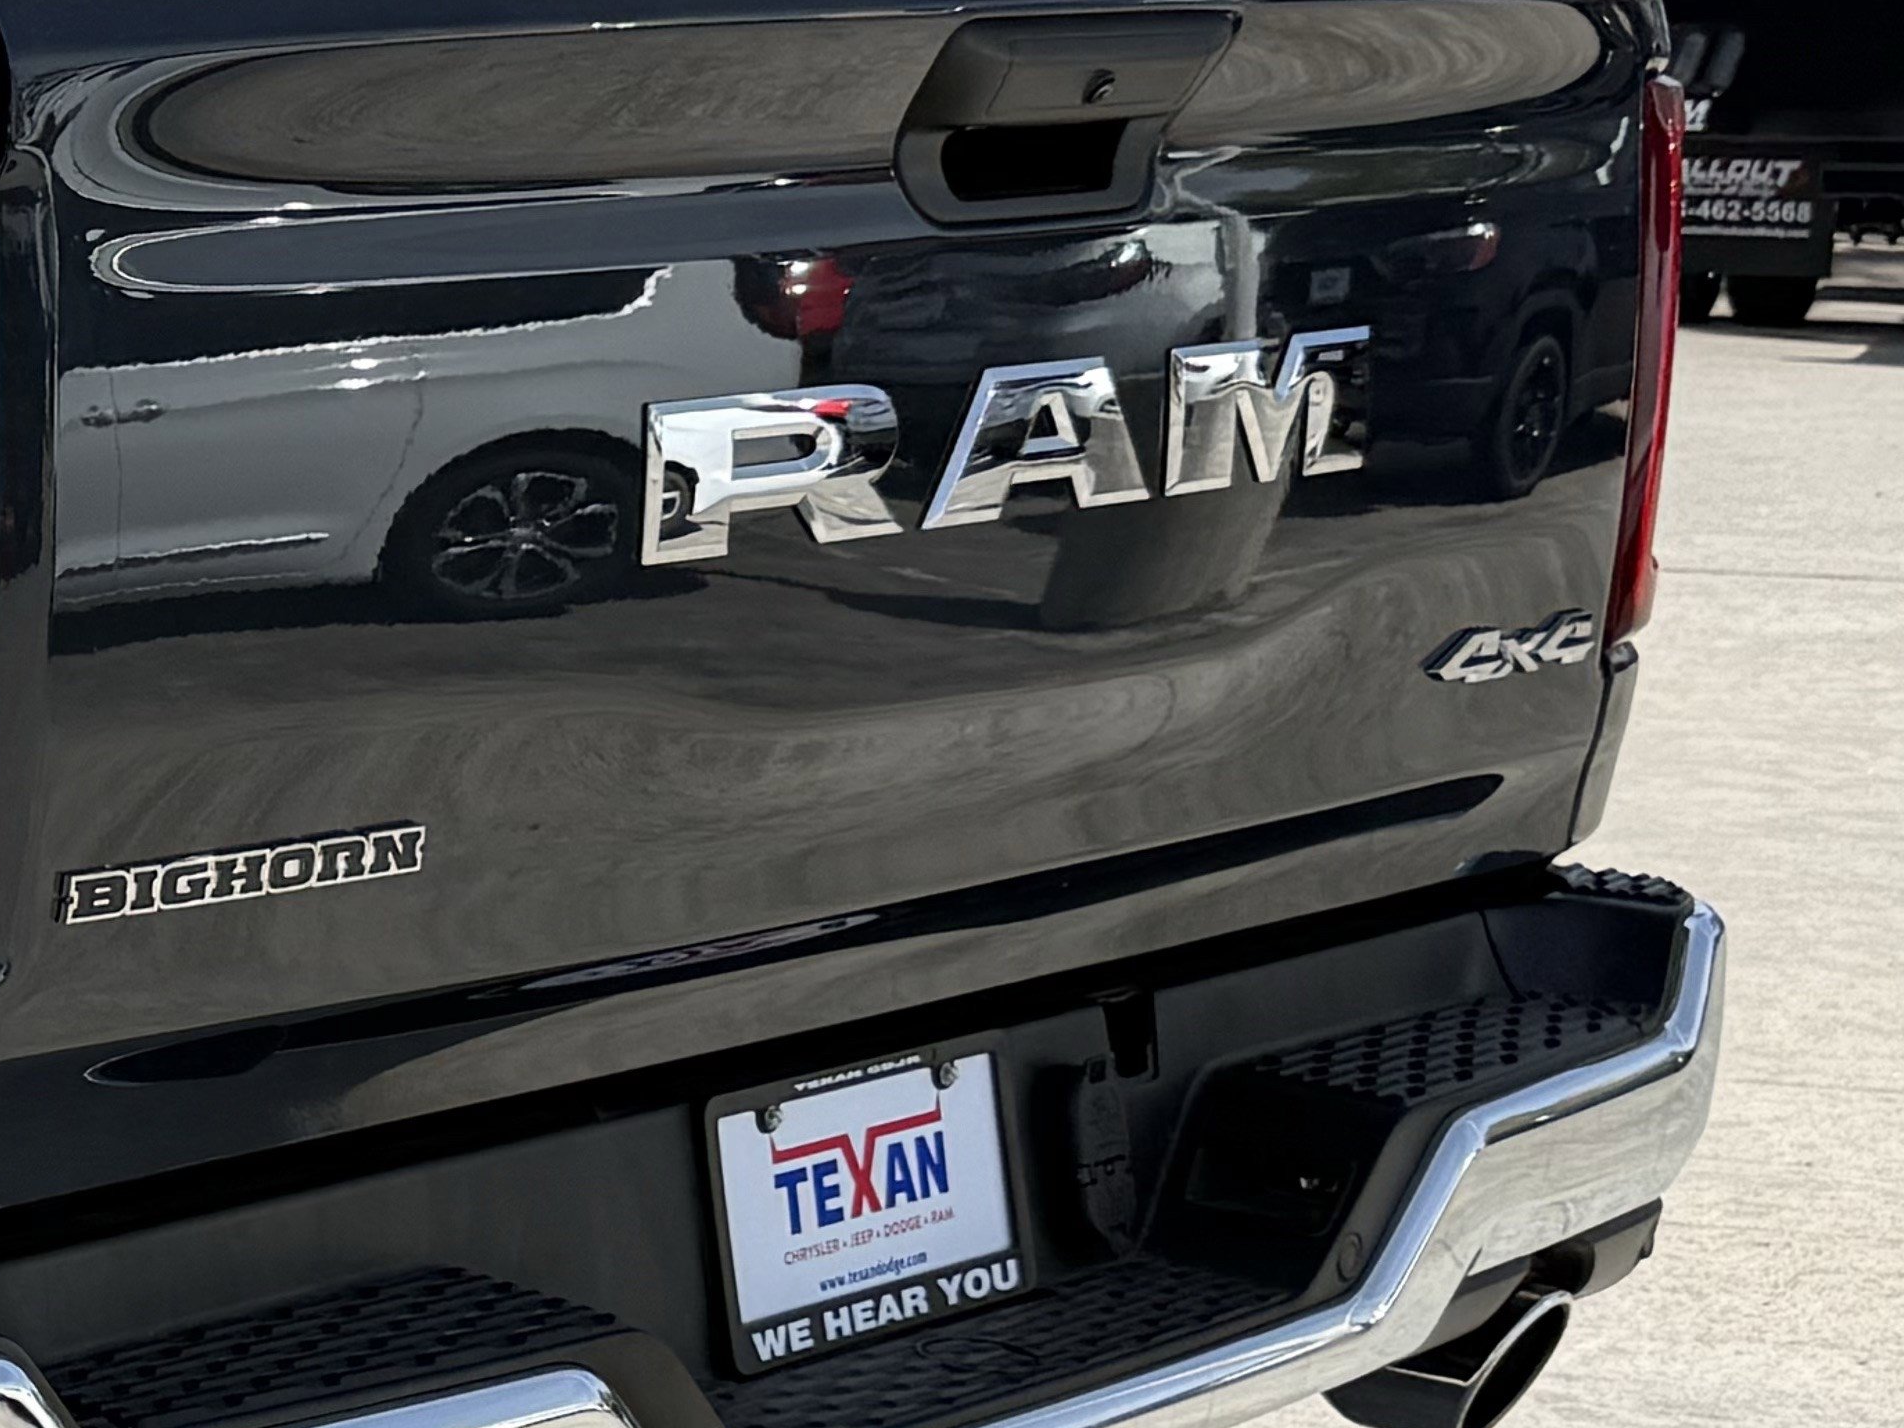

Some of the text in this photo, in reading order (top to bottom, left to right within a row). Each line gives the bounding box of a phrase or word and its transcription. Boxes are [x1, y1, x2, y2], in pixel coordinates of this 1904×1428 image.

[641, 325, 1370, 566] RAM
[56, 821, 427, 925] BIGHORN
[772, 1120, 950, 1235] TEXAN
[783, 1206, 956, 1265] CHRYSLER JEEP DODGE RAM
[818, 1250, 928, 1292] www.texandodge.com
[751, 1258, 1020, 1362] WE HEAR YOU
